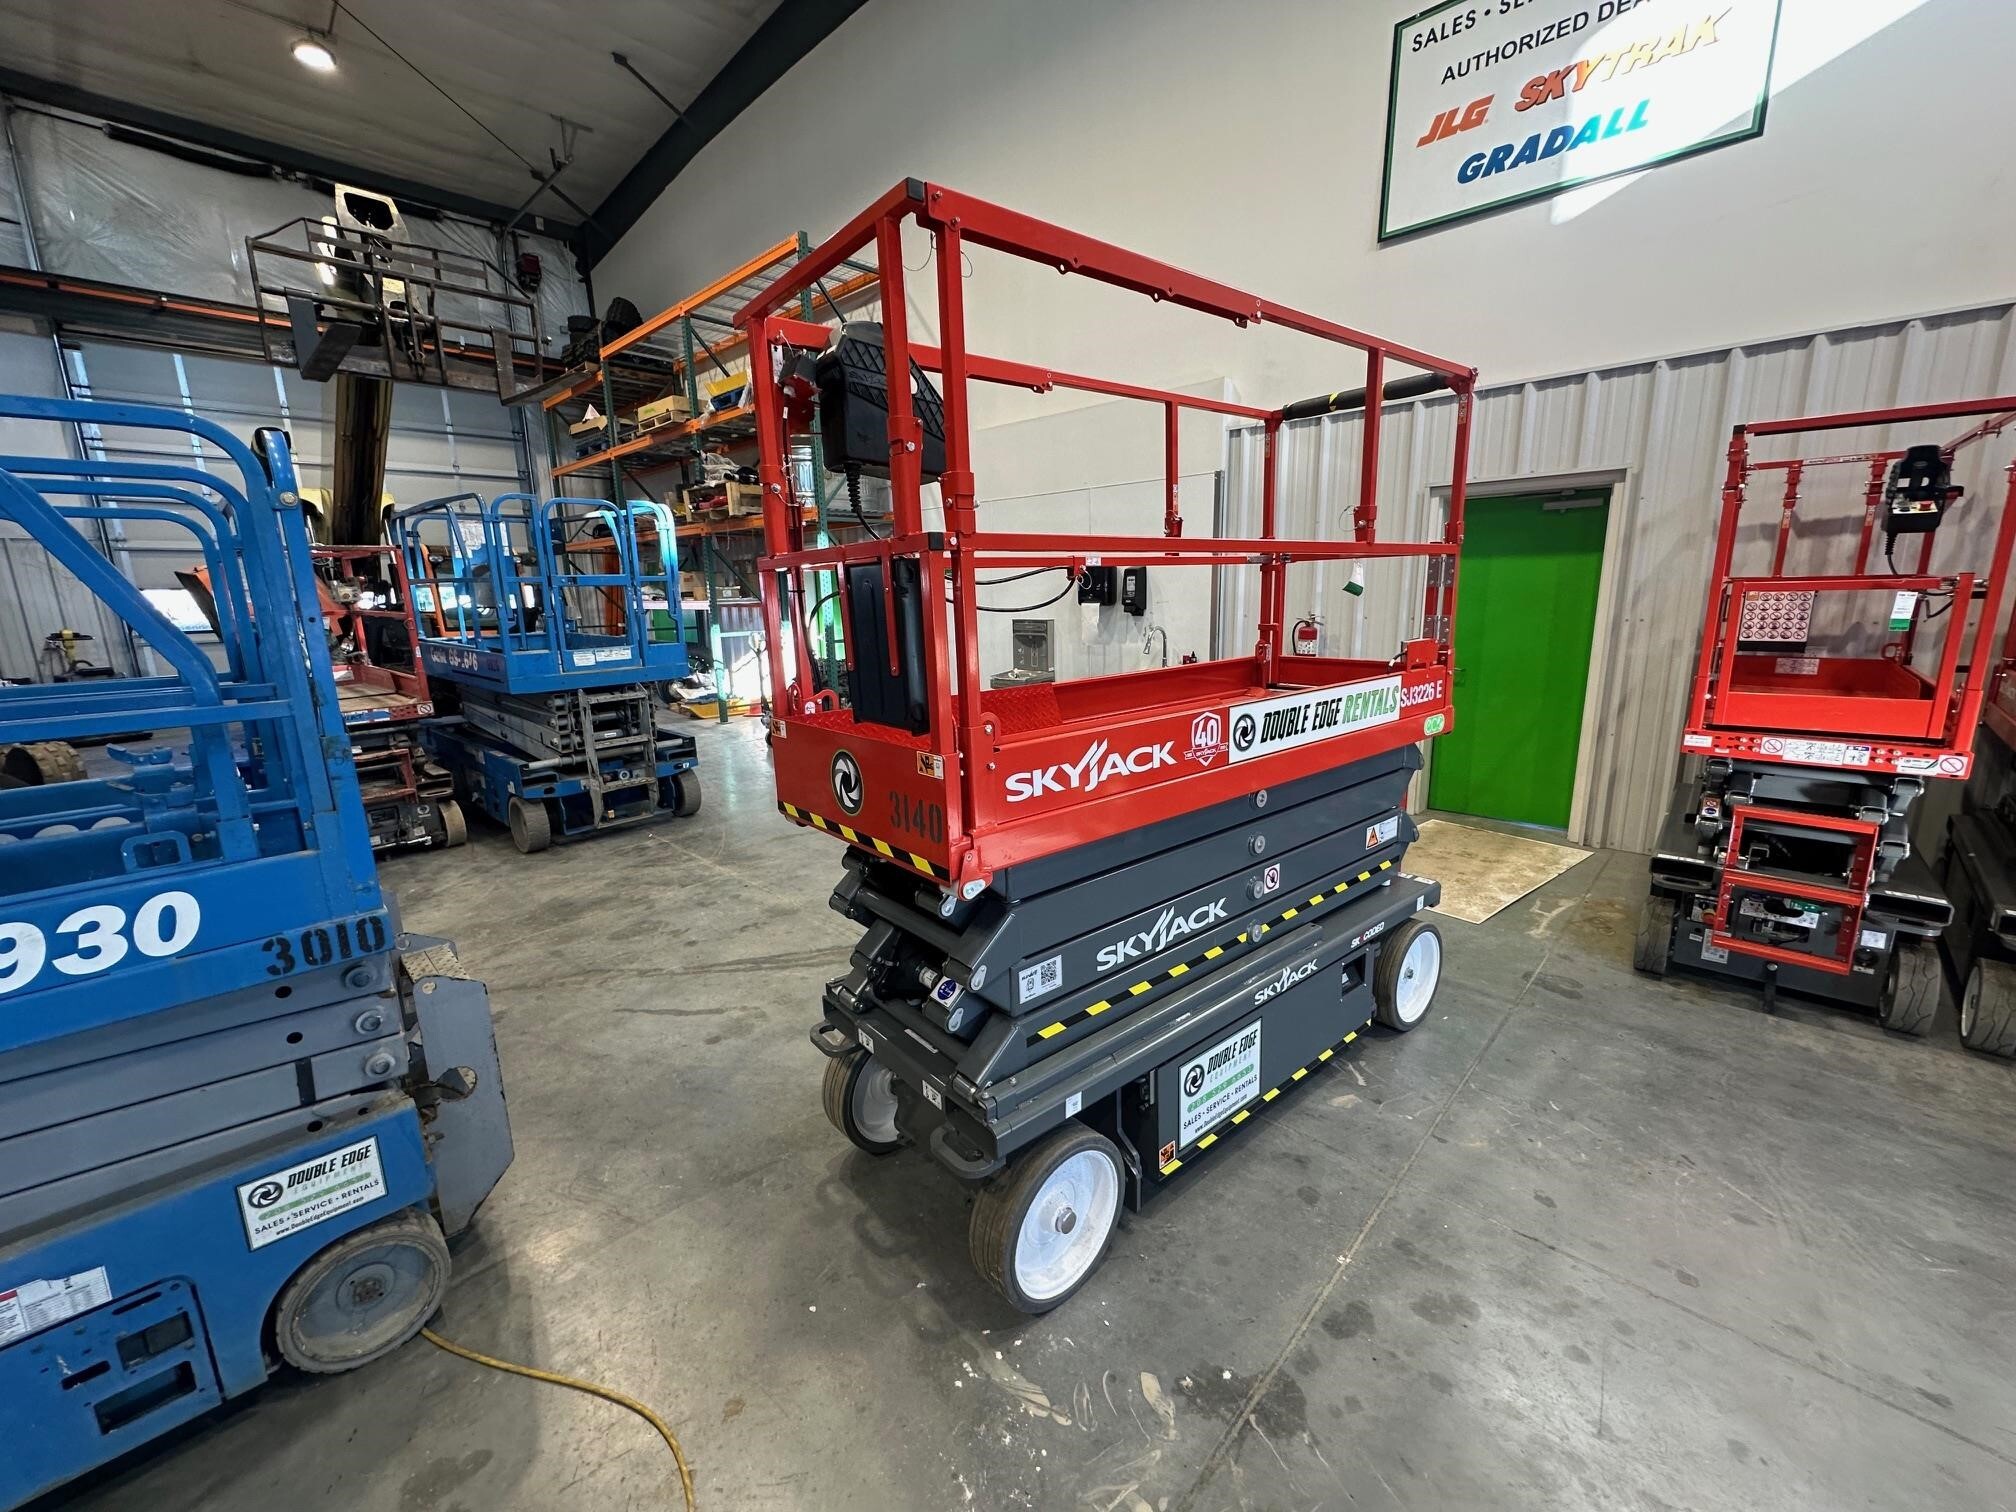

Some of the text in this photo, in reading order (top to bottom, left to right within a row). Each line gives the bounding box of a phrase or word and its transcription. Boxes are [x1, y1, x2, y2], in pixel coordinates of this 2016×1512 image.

[1412, 9, 1477, 53] SALES
[1440, 11, 1590, 85] AUTHORIZED
[1416, 7, 1732, 148] JLG SKYTRAK
[1457, 99, 1651, 185] GRADALL
[1260, 704, 1310, 744] DOUBLE
[1312, 697, 1342, 731] EDGE
[1342, 685, 1399, 725] RENTALS
[1400, 679, 1443, 708] SJ3226 E
[1194, 718, 1218, 748] 40
[1006, 737, 1177, 803] SKYJACK
[889, 791, 943, 845] 3140
[0, 890, 201, 995] 930
[261, 915, 386, 977] 3010
[1097, 897, 1229, 973] SKYJACK
[1254, 958, 1318, 1006] SKYJACK
[1207, 1029, 1258, 1076] DOUBLE EDGE
[1183, 1112, 1202, 1130] SALES
[1206, 1092, 1231, 1115] SERVICE
[1234, 1074, 1258, 1095] RENTALS
[287, 1144, 372, 1189] DOUBLE EDGE
[255, 1217, 285, 1235] SALES
[293, 1197, 333, 1220] SERVICE
[341, 1179, 380, 1199] RENTALS
